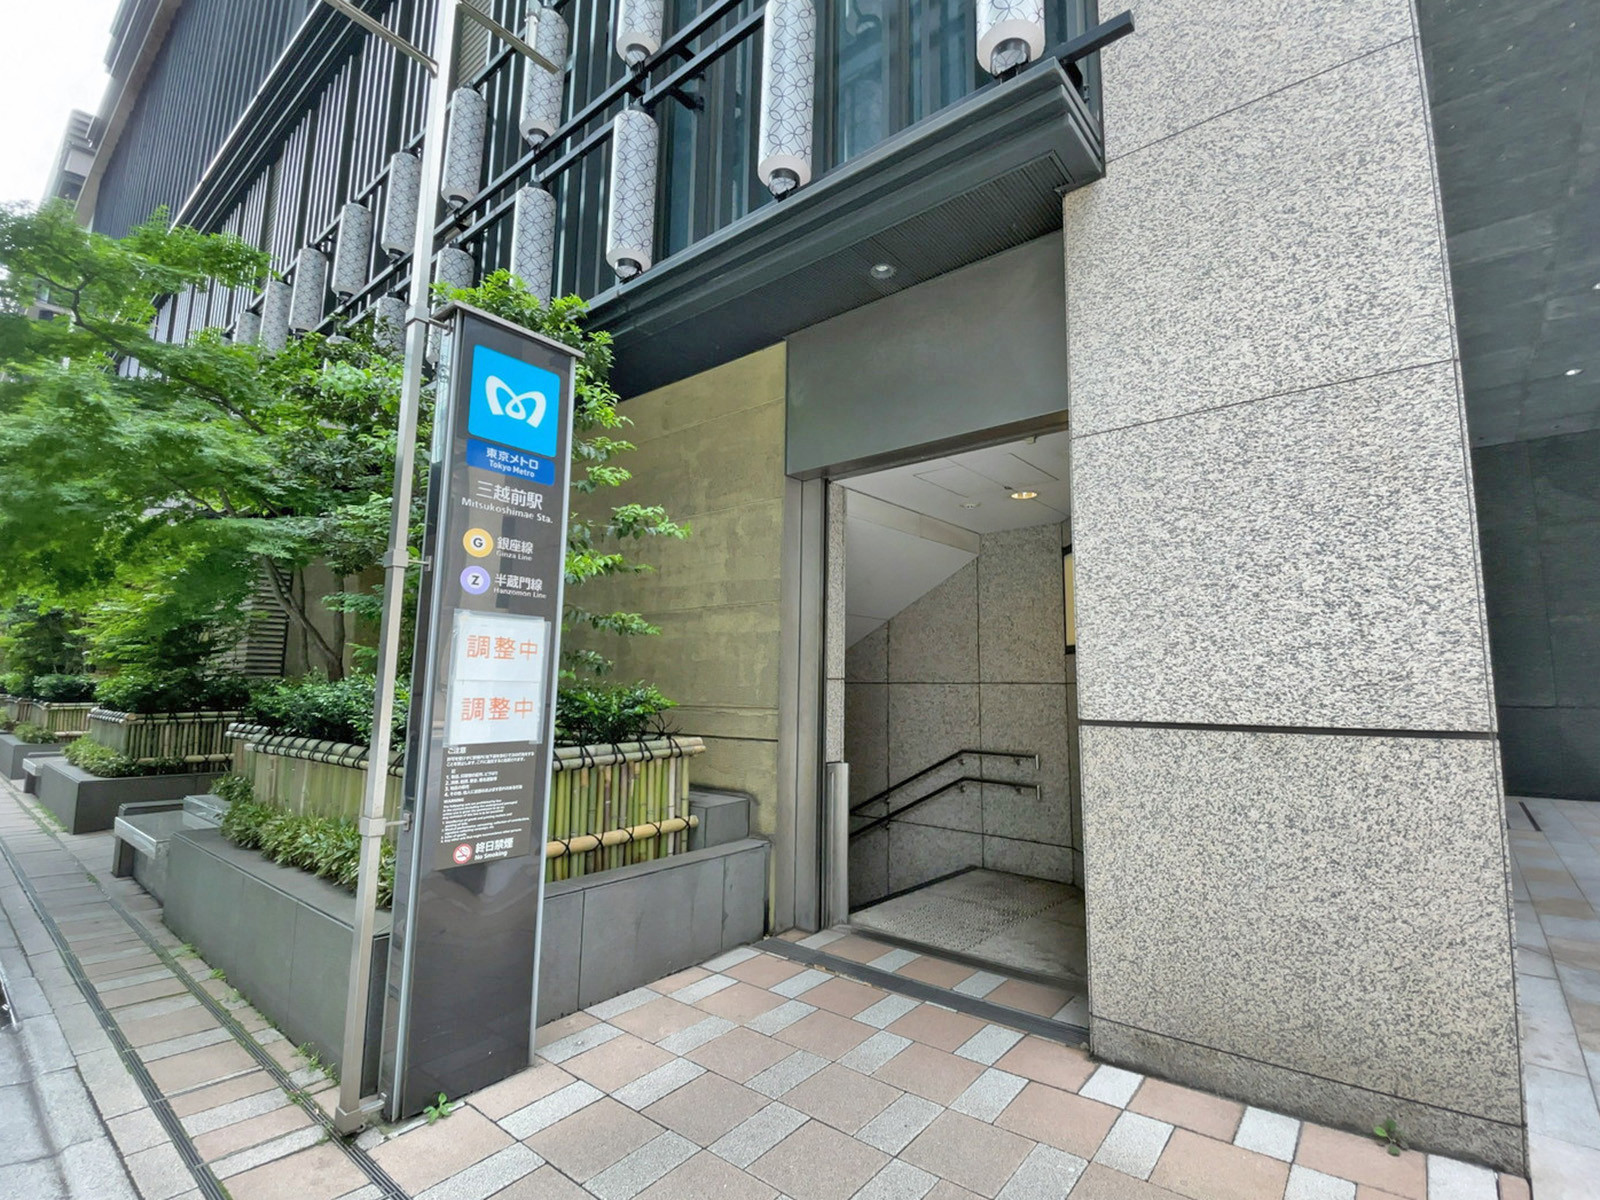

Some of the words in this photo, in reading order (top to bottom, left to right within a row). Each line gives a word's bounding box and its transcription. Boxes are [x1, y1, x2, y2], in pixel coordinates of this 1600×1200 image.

[486, 447, 539, 470] 東京メトロ
[489, 459, 512, 472] Tokyo
[512, 466, 535, 478] Metro
[476, 480, 543, 510] 三越前駅
[461, 497, 534, 520] Mitsukoshimae
[536, 513, 553, 524] Sta.
[473, 537, 483, 548] G
[496, 536, 534, 554] 銀座線
[496, 550, 517, 559] Ginza
[518, 553, 533, 561] Line
[471, 574, 480, 586] Z
[494, 573, 543, 591] 半蔵門線
[493, 587, 531, 597] Hanzomon
[532, 591, 547, 599] Line
[467, 634, 538, 661] 調整中
[461, 696, 533, 721] 調整中
[475, 837, 514, 854] 終日禁煙
[484, 850, 508, 859] Smoking
